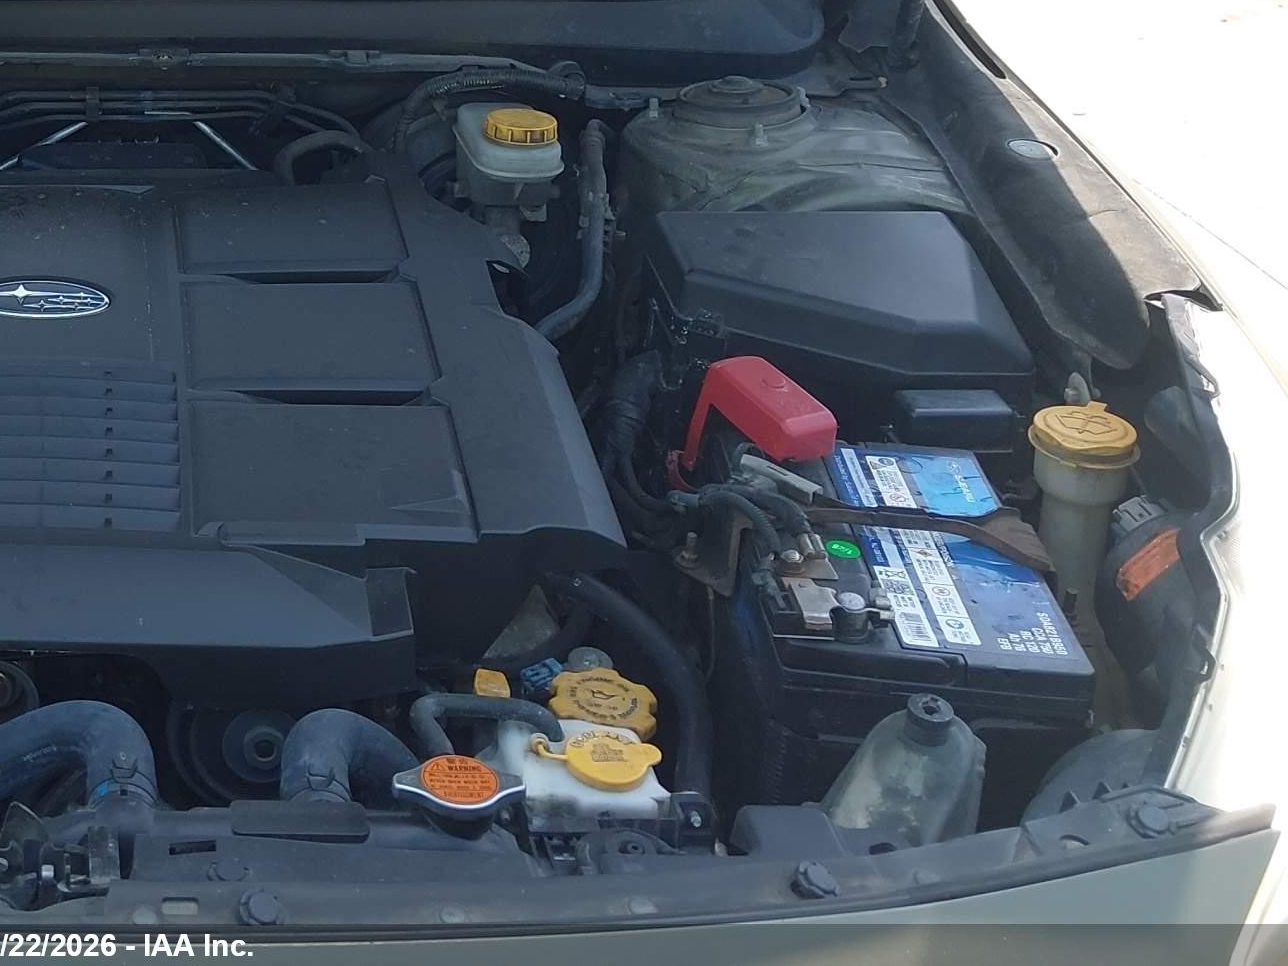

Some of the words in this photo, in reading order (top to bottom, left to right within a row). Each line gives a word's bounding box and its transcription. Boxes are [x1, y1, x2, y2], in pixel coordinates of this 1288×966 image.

[1019, 630, 1034, 640] RC
[1032, 627, 1048, 641] CCA
[1025, 641, 1040, 653] 120
